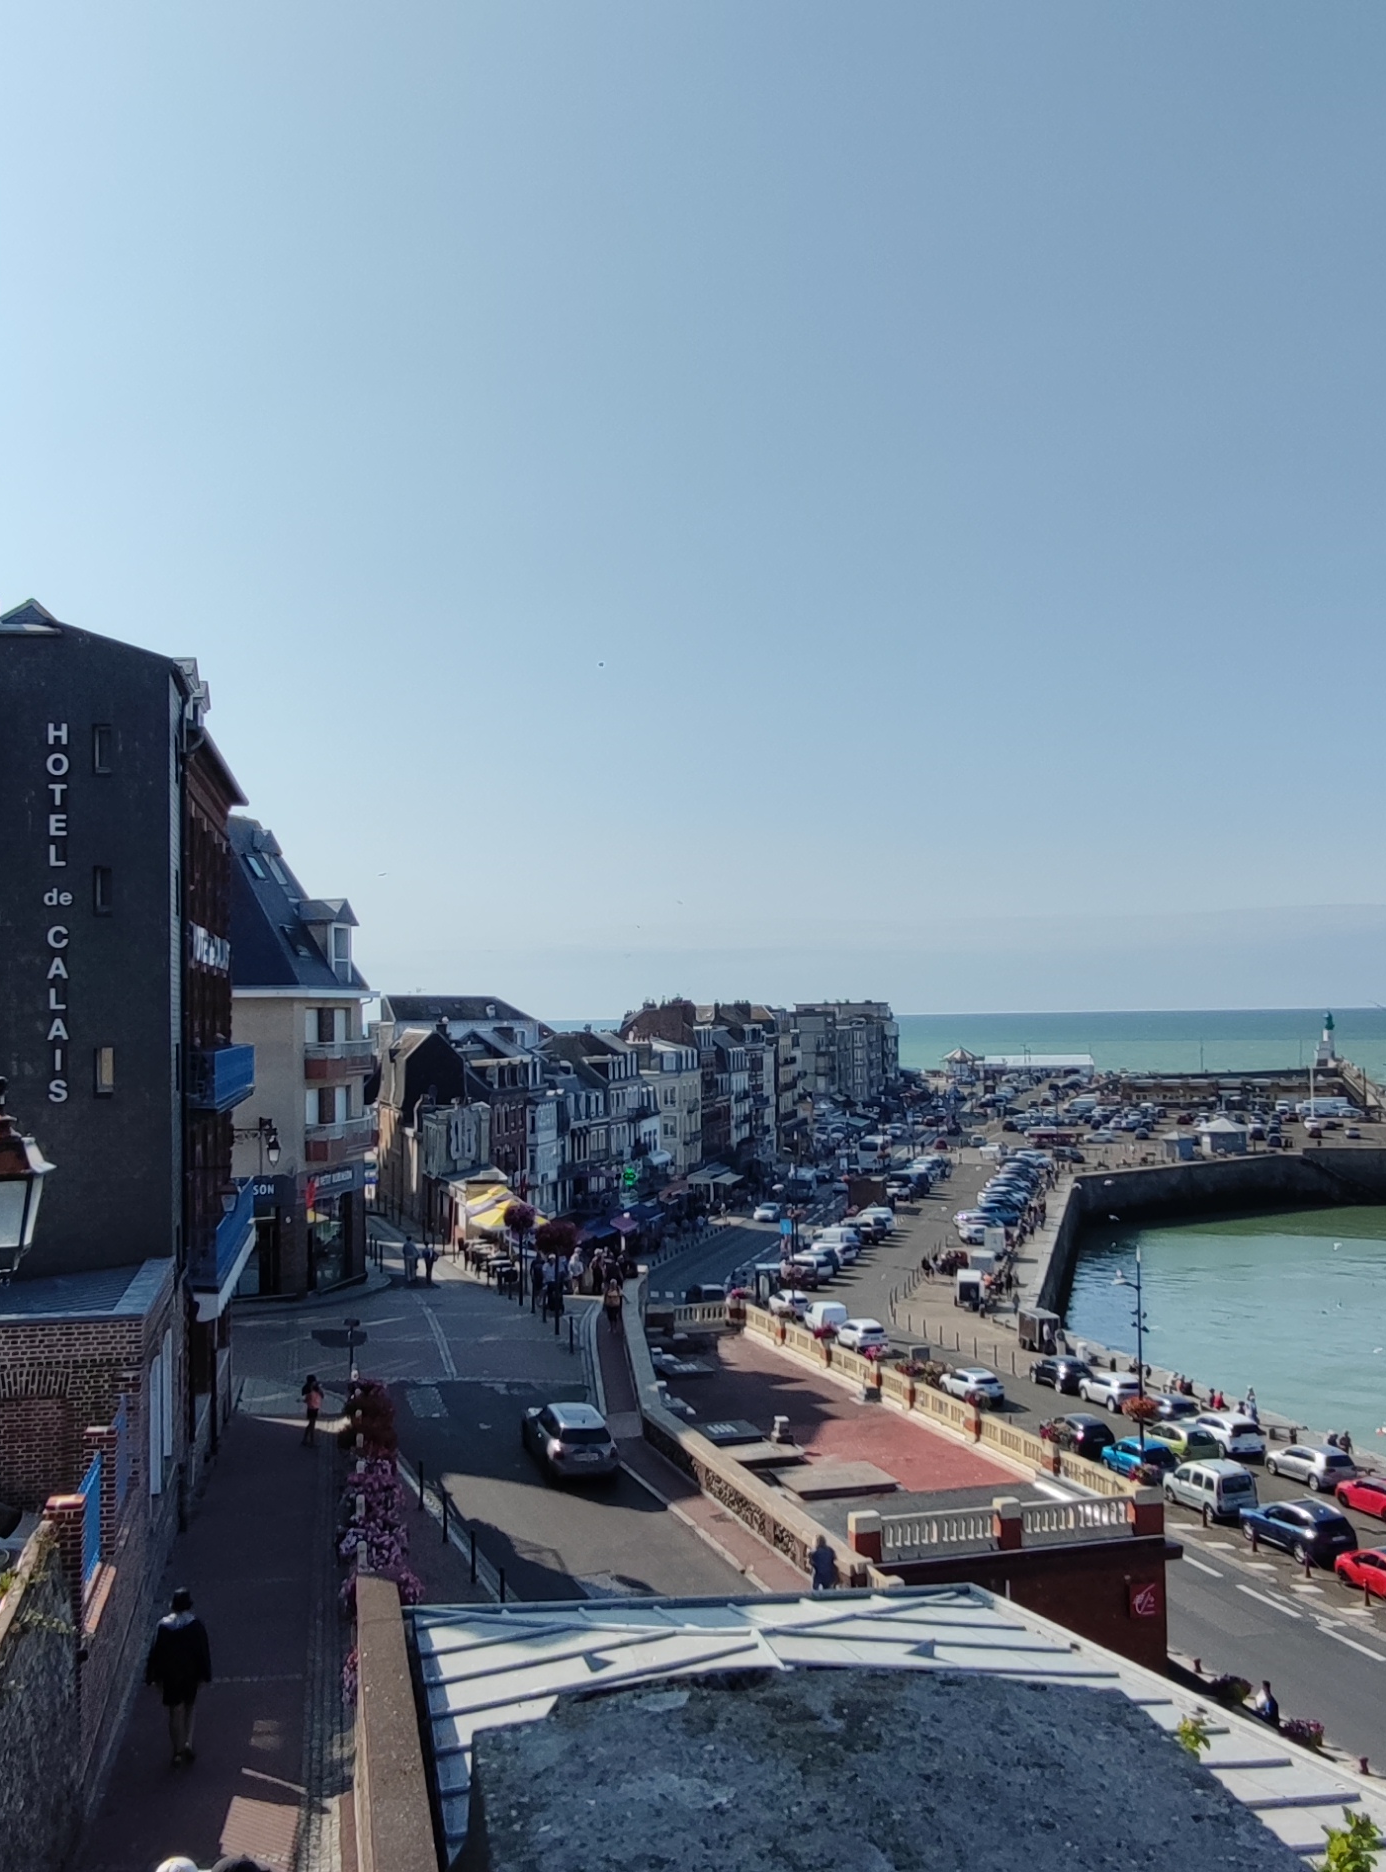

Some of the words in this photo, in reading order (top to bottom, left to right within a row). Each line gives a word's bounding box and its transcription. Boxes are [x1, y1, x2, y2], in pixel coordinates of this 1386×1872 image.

[47, 722, 68, 867] HOTEL
[43, 887, 73, 906] de
[47, 925, 69, 1102] CALAIS
